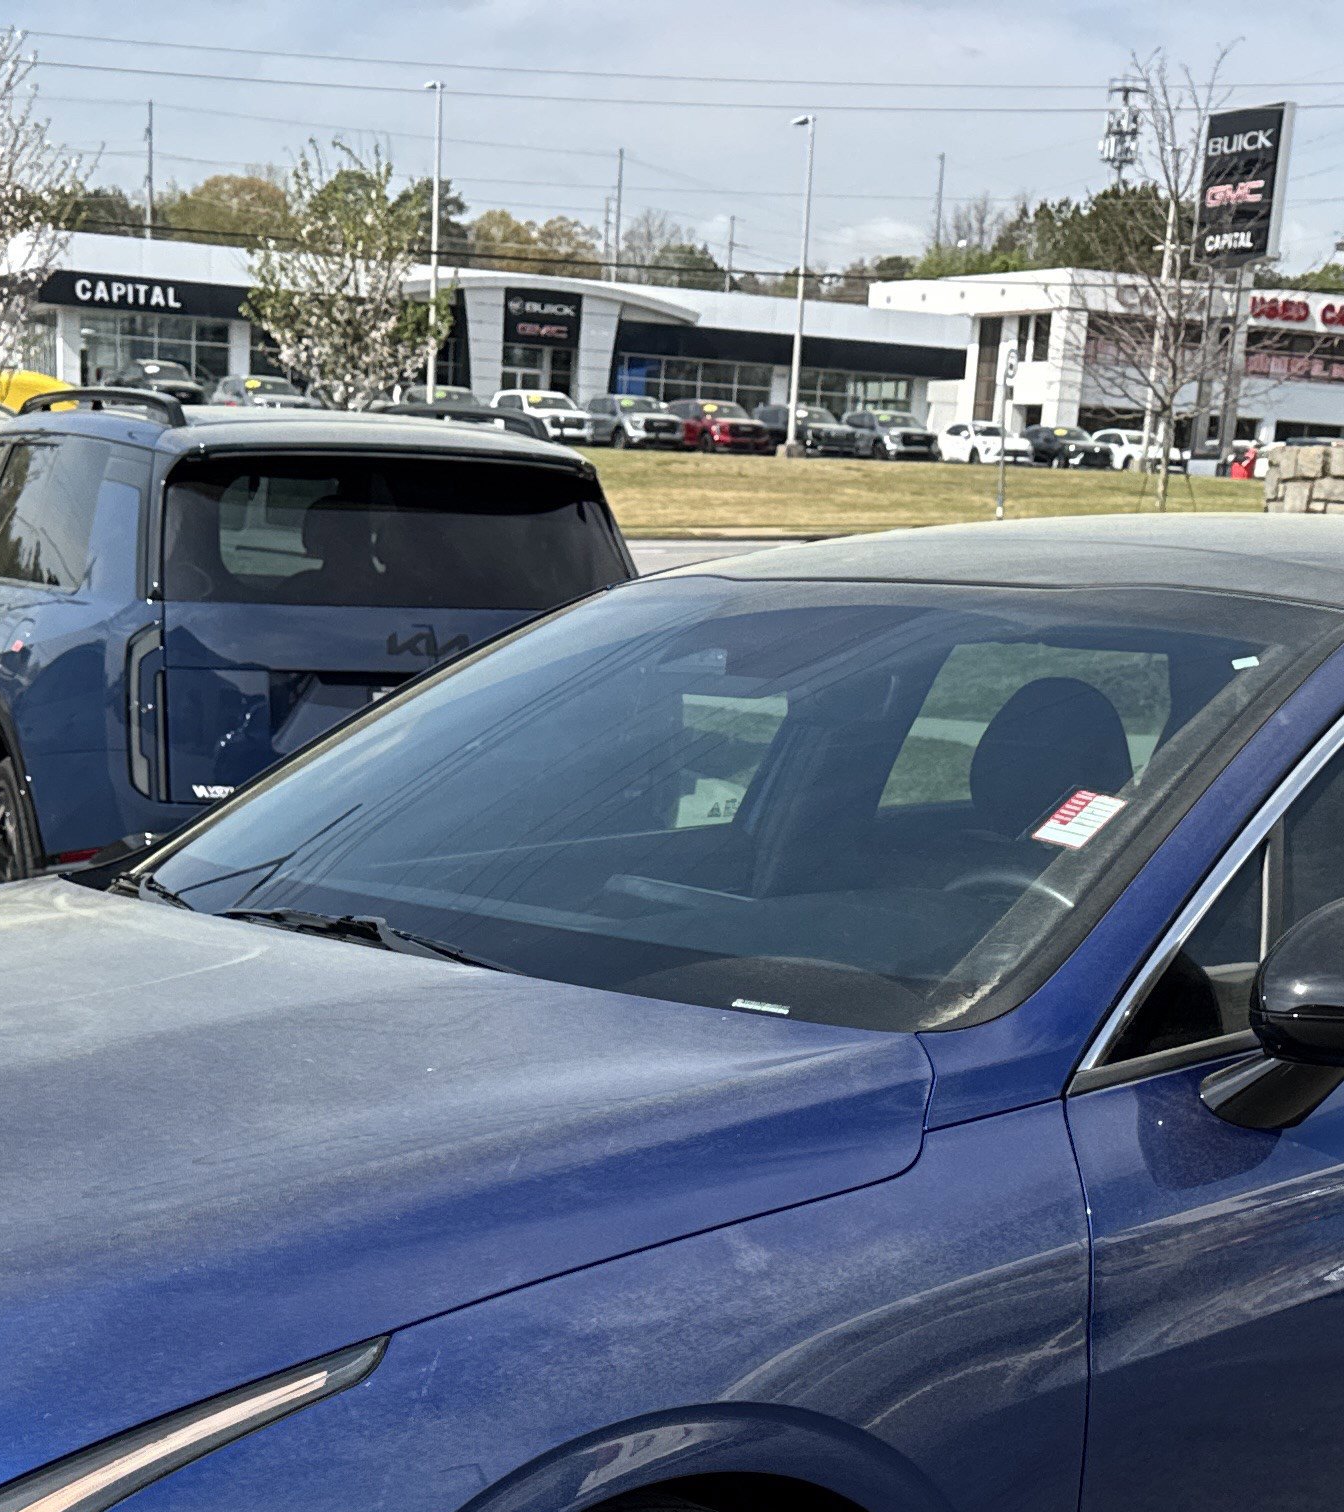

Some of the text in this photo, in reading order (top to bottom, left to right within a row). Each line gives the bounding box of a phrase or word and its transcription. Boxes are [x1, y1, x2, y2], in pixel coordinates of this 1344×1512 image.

[1208, 128, 1275, 156] BUICK
[1206, 180, 1265, 207] GMC
[1205, 231, 1254, 251] CAPITAL
[74, 279, 182, 308] CAPITAL
[524, 301, 576, 317] BUICK
[1251, 296, 1309, 321] USED
[516, 322, 568, 339] GMC
